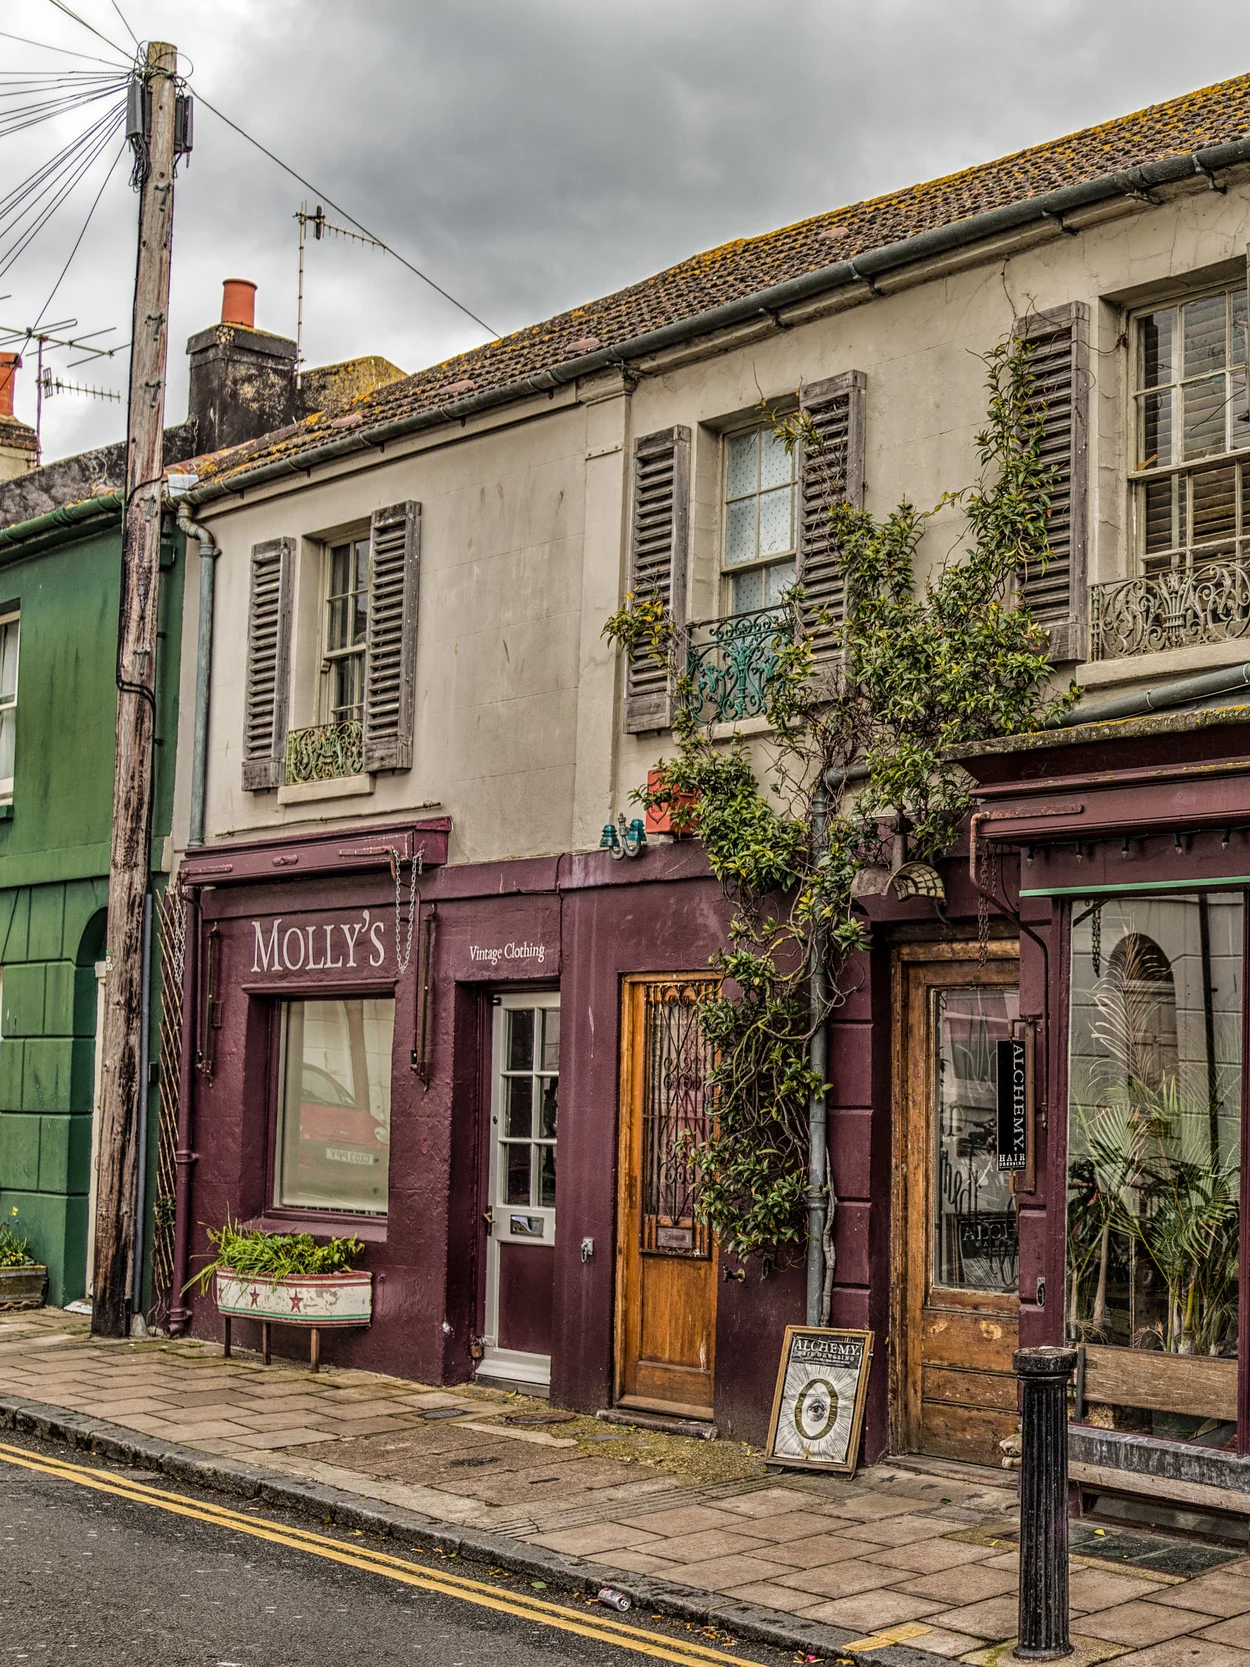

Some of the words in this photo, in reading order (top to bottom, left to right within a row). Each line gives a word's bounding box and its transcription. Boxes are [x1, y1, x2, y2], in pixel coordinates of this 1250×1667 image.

[251, 909, 385, 972] MOLLY'S
[469, 945, 503, 966] Vintage
[504, 941, 545, 963] Clothing
[999, 1153, 1026, 1162] HAIR
[794, 1339, 861, 1356] ALCHEMY.
